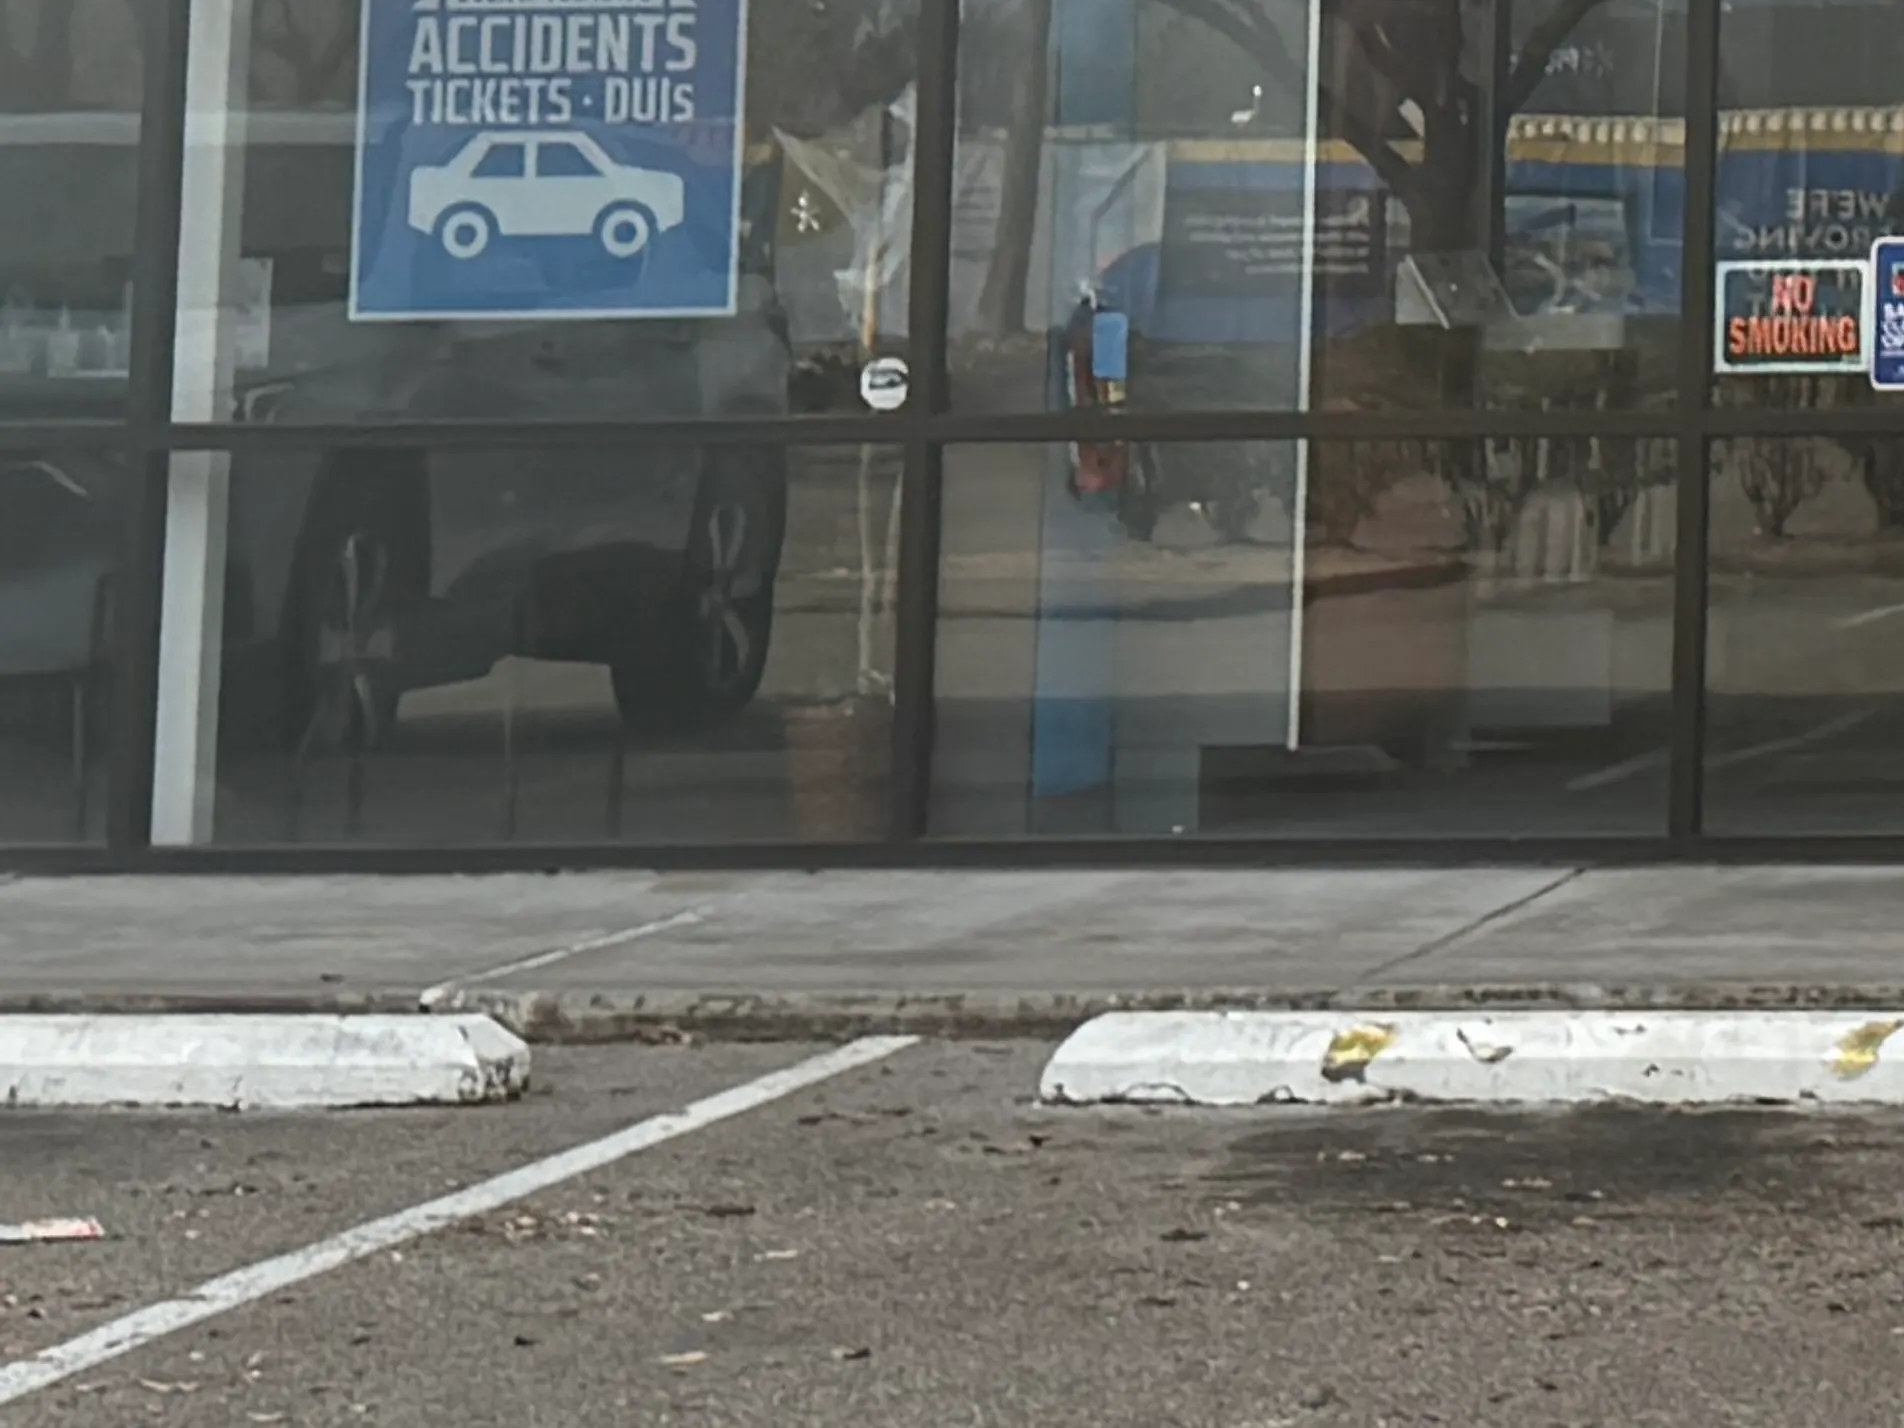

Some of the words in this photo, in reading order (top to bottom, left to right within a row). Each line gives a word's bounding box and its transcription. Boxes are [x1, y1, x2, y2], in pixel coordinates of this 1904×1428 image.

[408, 15, 696, 73] ACCIDENTS
[406, 79, 571, 124] TICKETS
[605, 76, 694, 123] DUIs
[1772, 274, 1816, 312] NO
[1730, 315, 1856, 354] SMOKING
